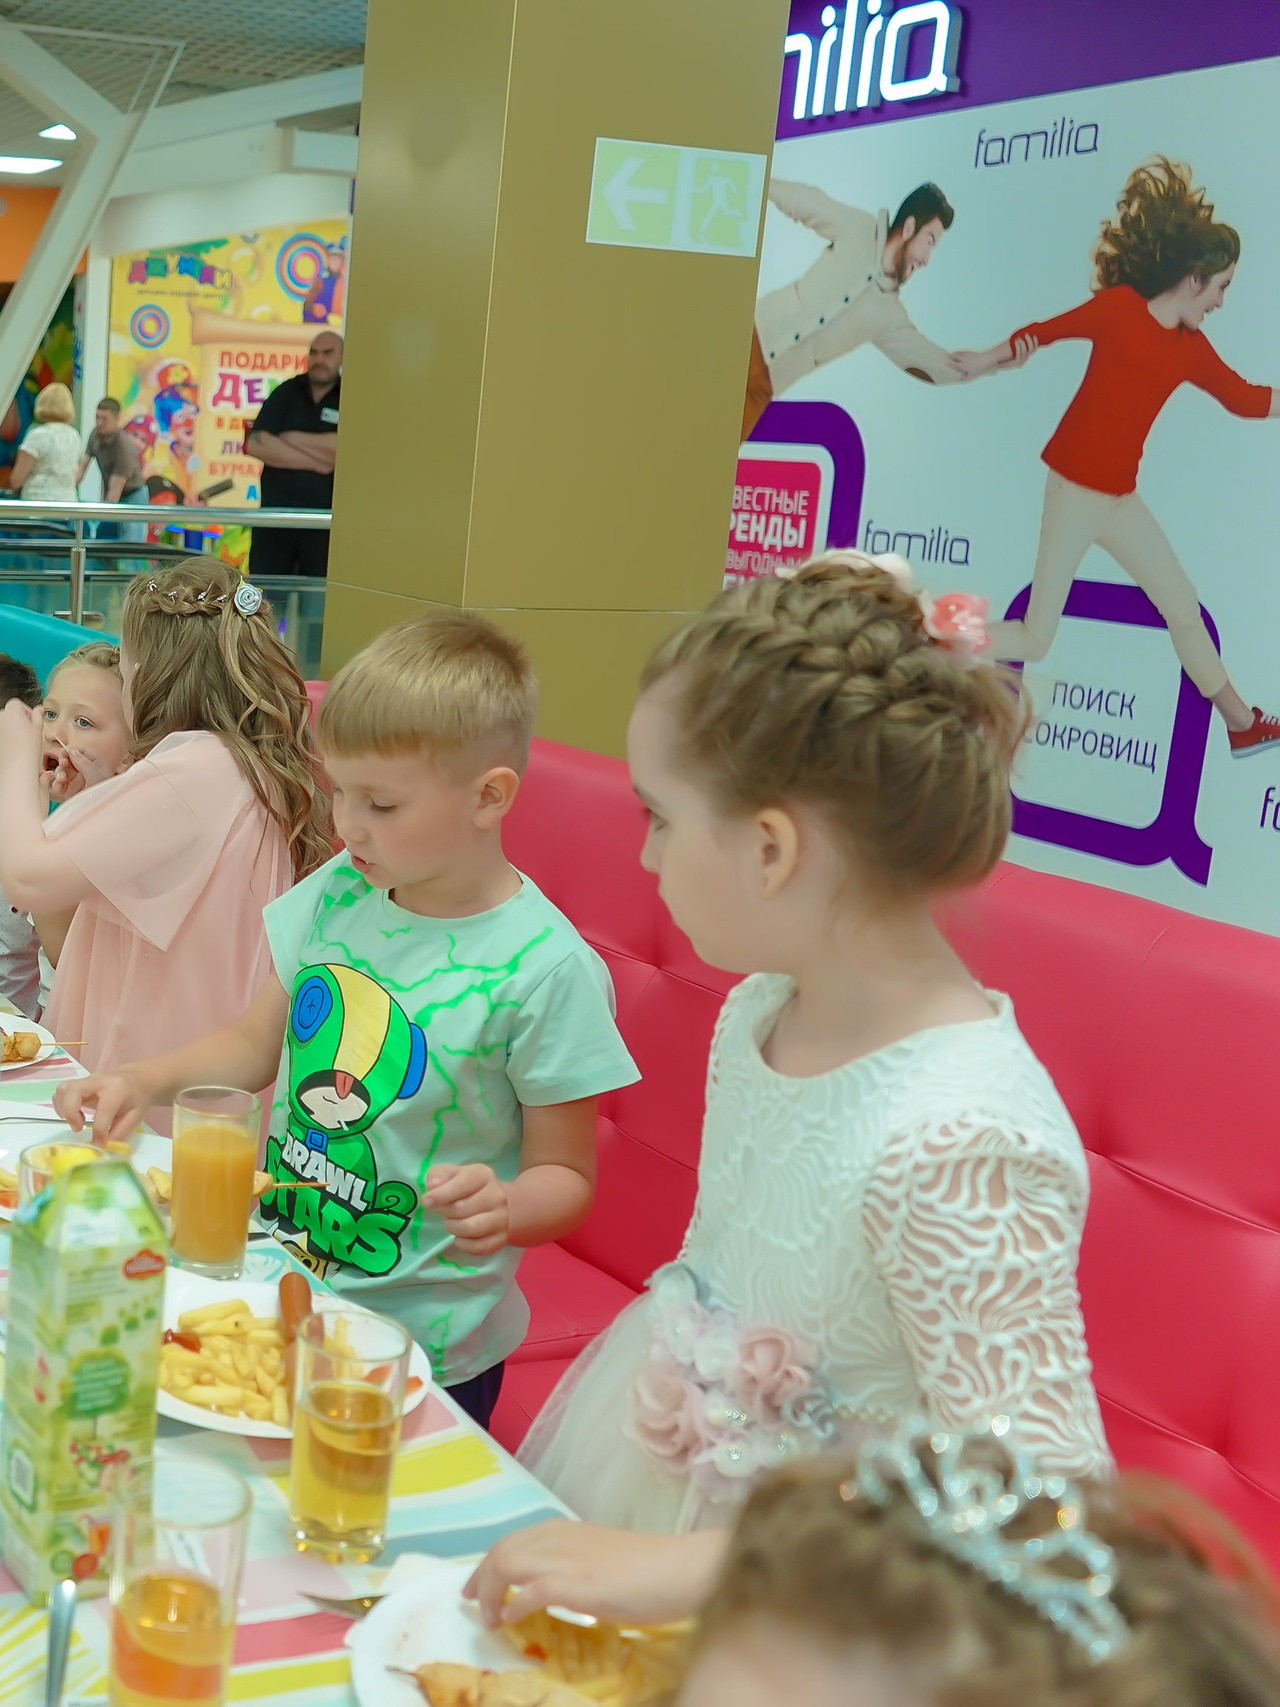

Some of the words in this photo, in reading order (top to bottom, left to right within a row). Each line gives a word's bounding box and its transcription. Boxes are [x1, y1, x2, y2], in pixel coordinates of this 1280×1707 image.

[973, 115, 1099, 169] familia
[732, 485, 810, 516] ВЕСТНЫЕ
[863, 518, 969, 566] familia
[1051, 680, 1136, 721] ПОИСК
[281, 1131, 369, 1212] BRAWL
[260, 1138, 407, 1274] STARS
